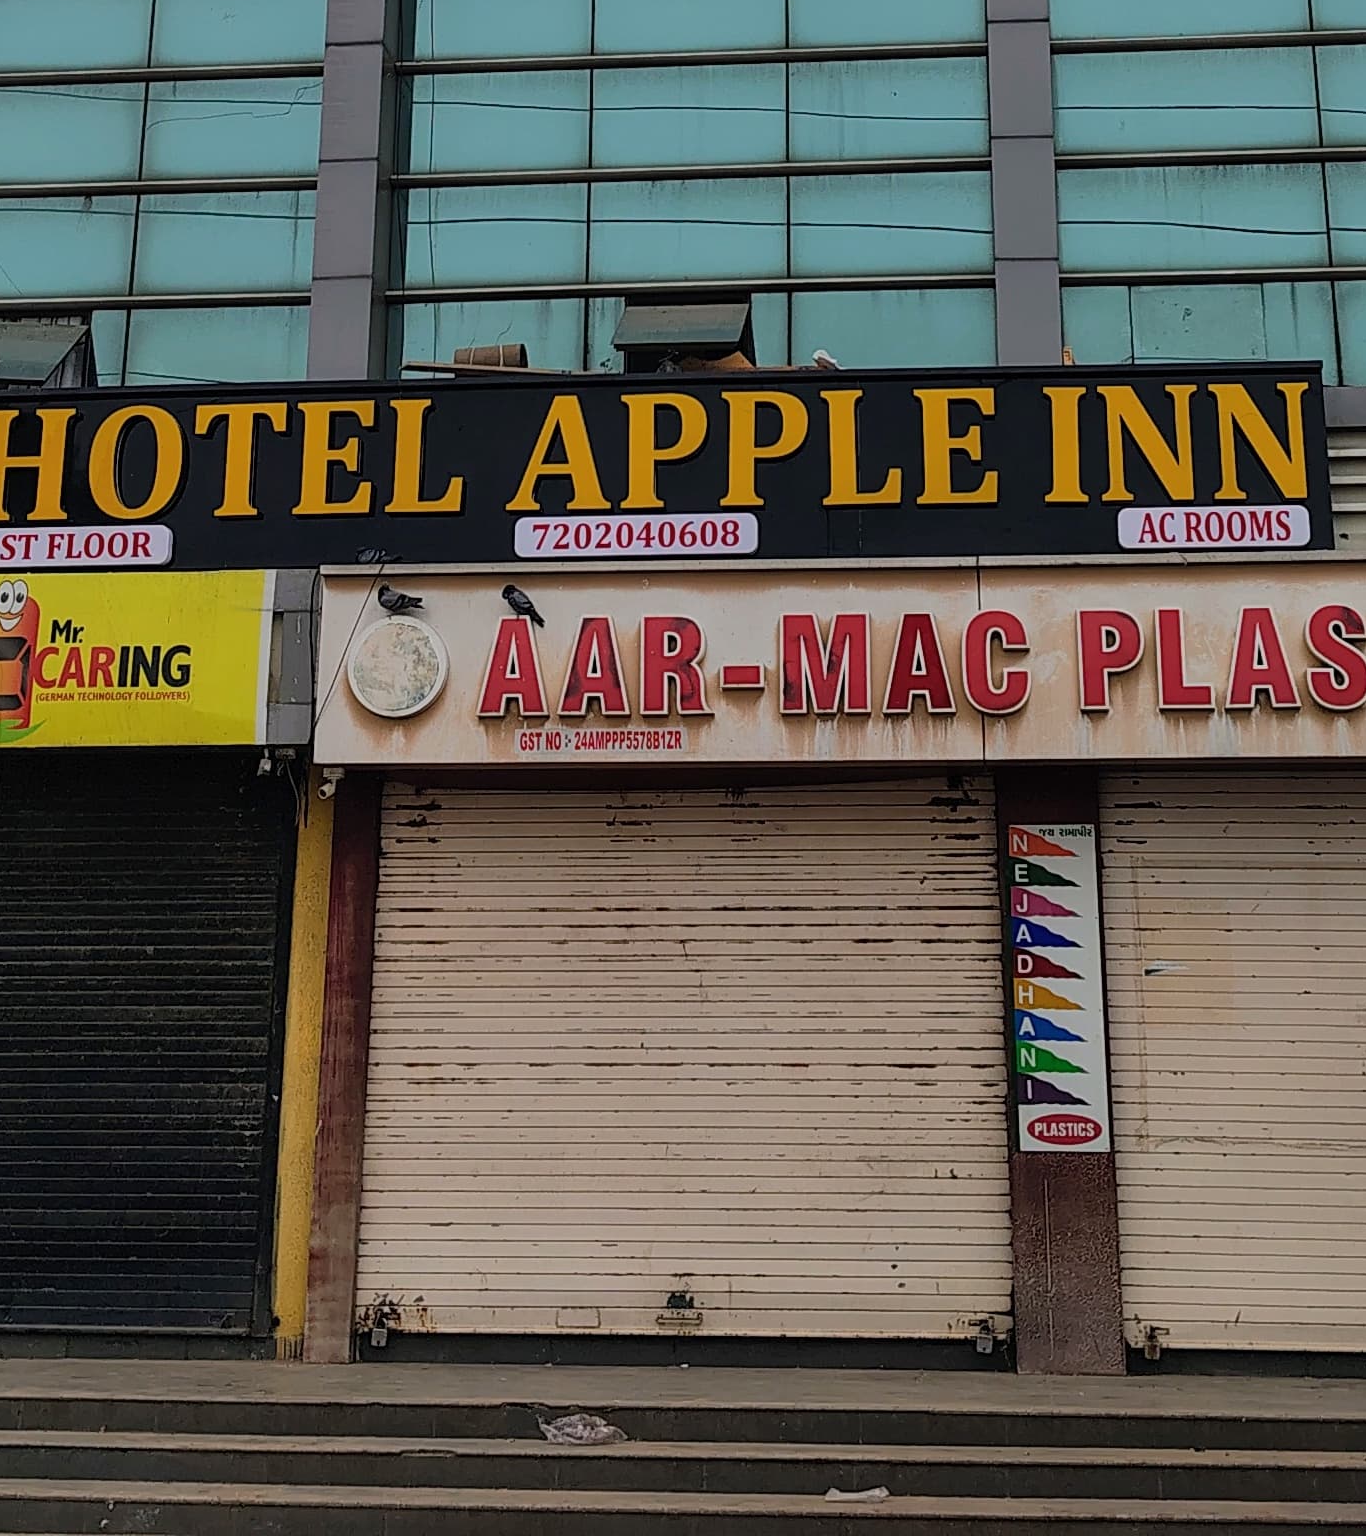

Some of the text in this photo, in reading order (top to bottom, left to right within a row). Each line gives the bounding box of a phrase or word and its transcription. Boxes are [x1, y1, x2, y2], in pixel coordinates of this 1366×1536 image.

[505, 387, 999, 512] APPLE
[1043, 381, 1309, 503] INN
[531, 519, 741, 552] 7202040608
[1138, 510, 1292, 544] AC ROOMS
[46, 531, 153, 561] FLOOR
[50, 619, 85, 644] Mr.
[34, 645, 192, 689] CARING
[477, 610, 1032, 718] AAR-MAC
[78, 691, 133, 702] TECHNOLOGY
[520, 732, 542, 751] GST
[545, 731, 562, 751] NO
[1034, 1121, 1096, 1138] PLASTICS
